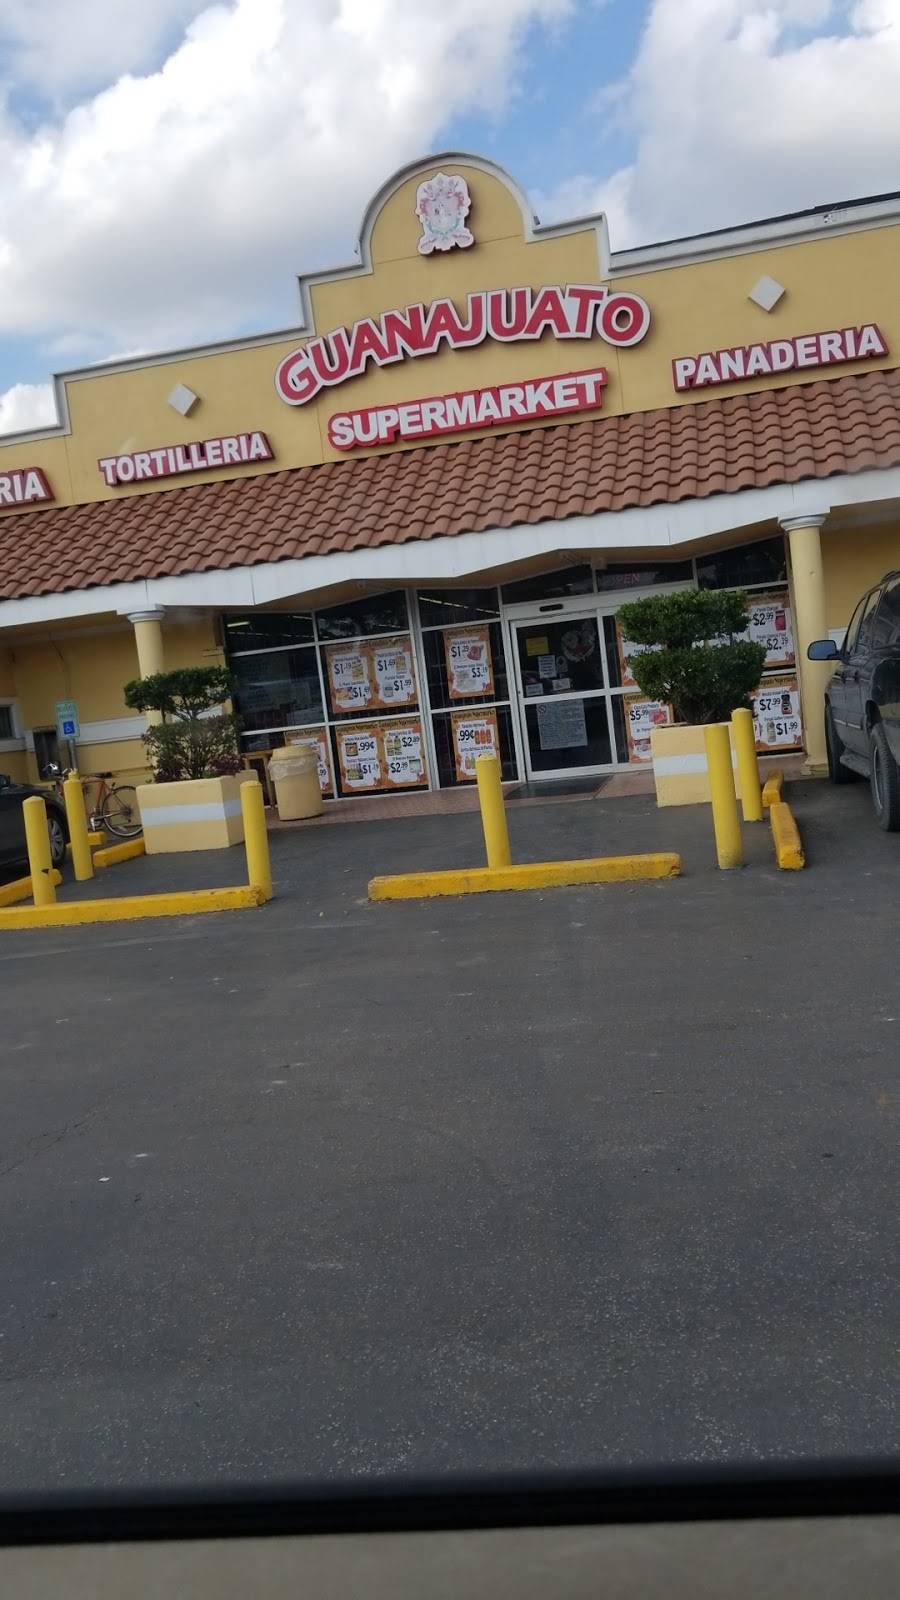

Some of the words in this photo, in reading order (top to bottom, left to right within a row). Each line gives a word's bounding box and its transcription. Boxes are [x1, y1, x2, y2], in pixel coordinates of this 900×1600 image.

[275, 285, 650, 405] GUANAJUATO
[675, 326, 885, 388] PANADERIA
[331, 372, 602, 447] SUPERMARKET
[0, 471, 46, 504] RIA
[100, 431, 269, 485] TORTILLERIA
